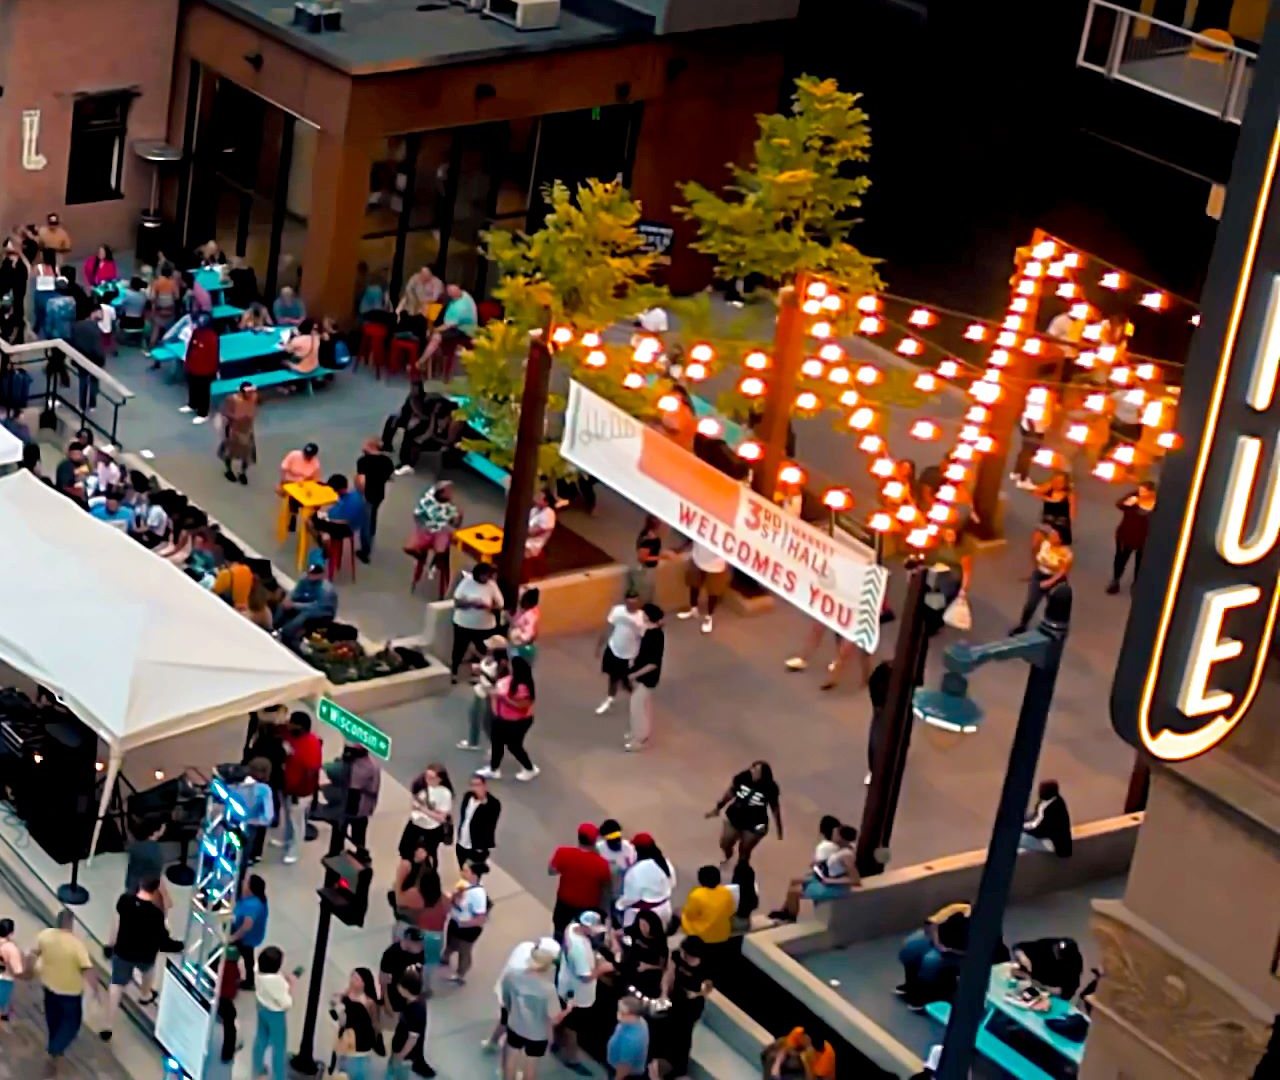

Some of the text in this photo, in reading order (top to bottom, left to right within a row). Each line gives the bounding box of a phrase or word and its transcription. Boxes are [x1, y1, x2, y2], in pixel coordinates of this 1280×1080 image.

[679, 502, 853, 627] WELCOMES YOU
[787, 538, 829, 578] HALL
[329, 707, 378, 749] Wisconsin
